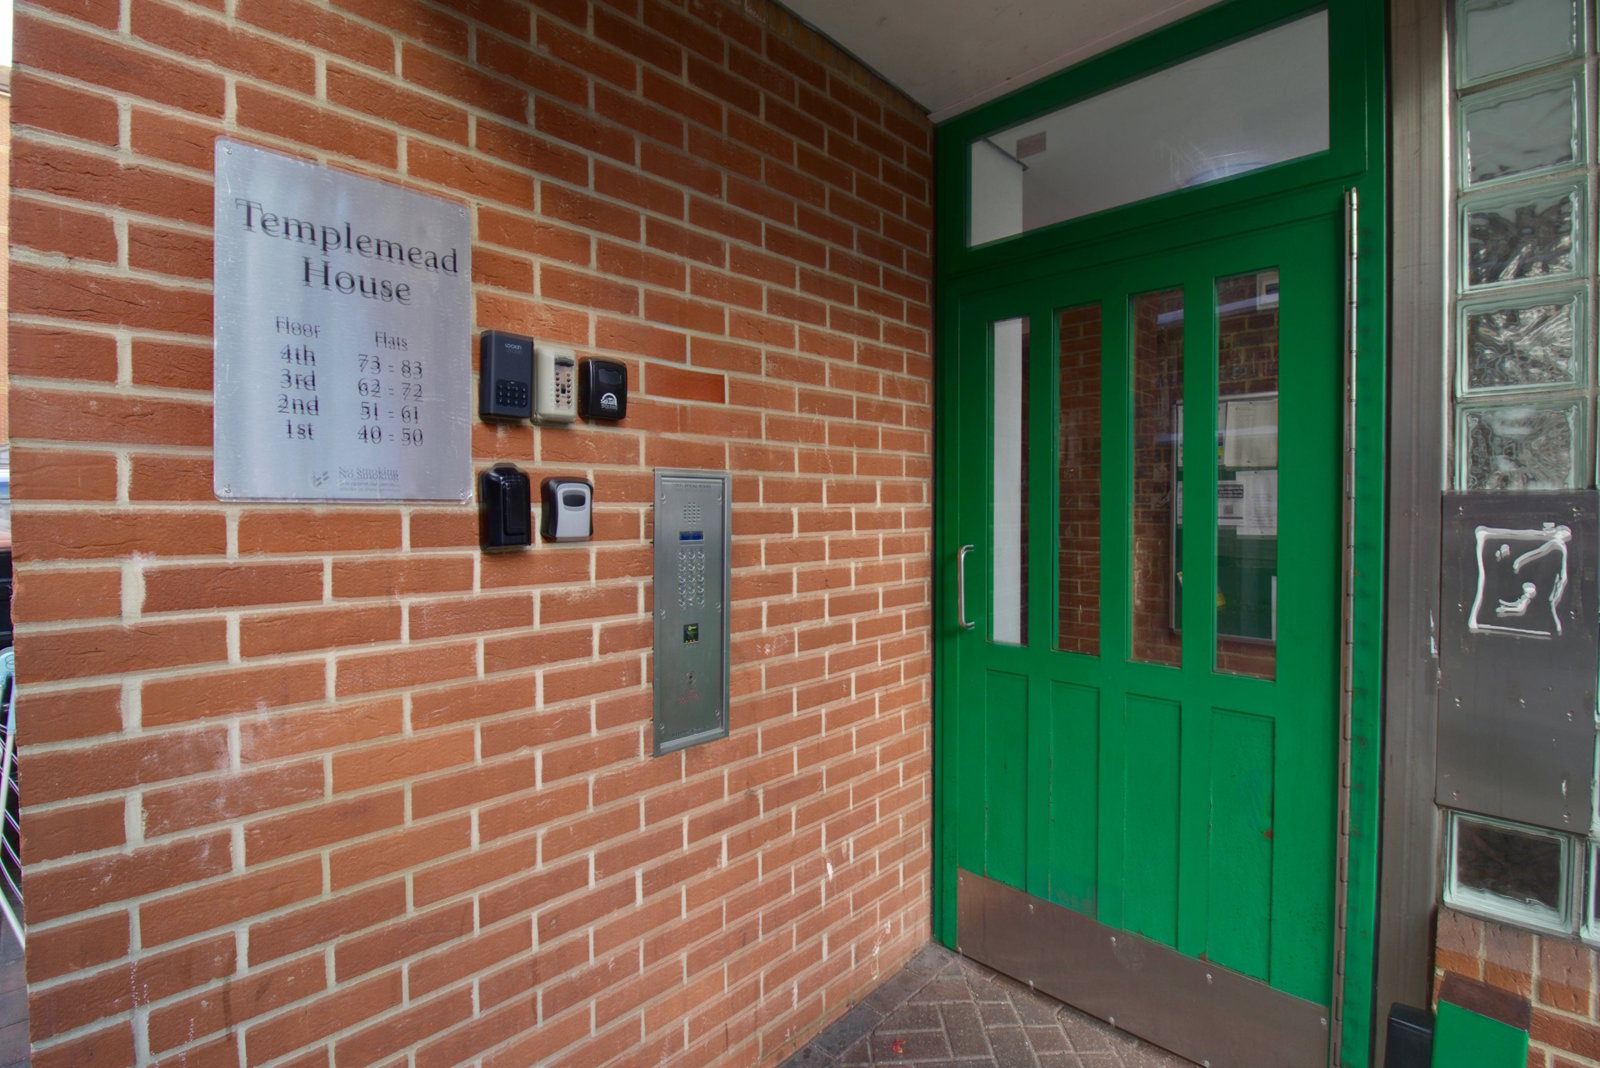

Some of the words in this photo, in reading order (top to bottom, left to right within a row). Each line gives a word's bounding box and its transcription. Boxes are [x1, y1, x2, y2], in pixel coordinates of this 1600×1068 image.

[234, 197, 460, 276] Templemead
[302, 256, 412, 306] House
[276, 315, 321, 339] Floor
[375, 331, 409, 351] Flats
[280, 344, 316, 367] 4th
[357, 354, 382, 376] 73
[400, 359, 424, 380] 83
[280, 368, 317, 391] 3rd
[357, 378, 382, 398] 62
[400, 382, 424, 402] 72
[277, 393, 320, 417] 2nd
[359, 401, 379, 421] 51
[400, 406, 420, 425] 61
[286, 419, 315, 441] 1st
[357, 425, 382, 445] 40
[400, 428, 424, 447] 50
